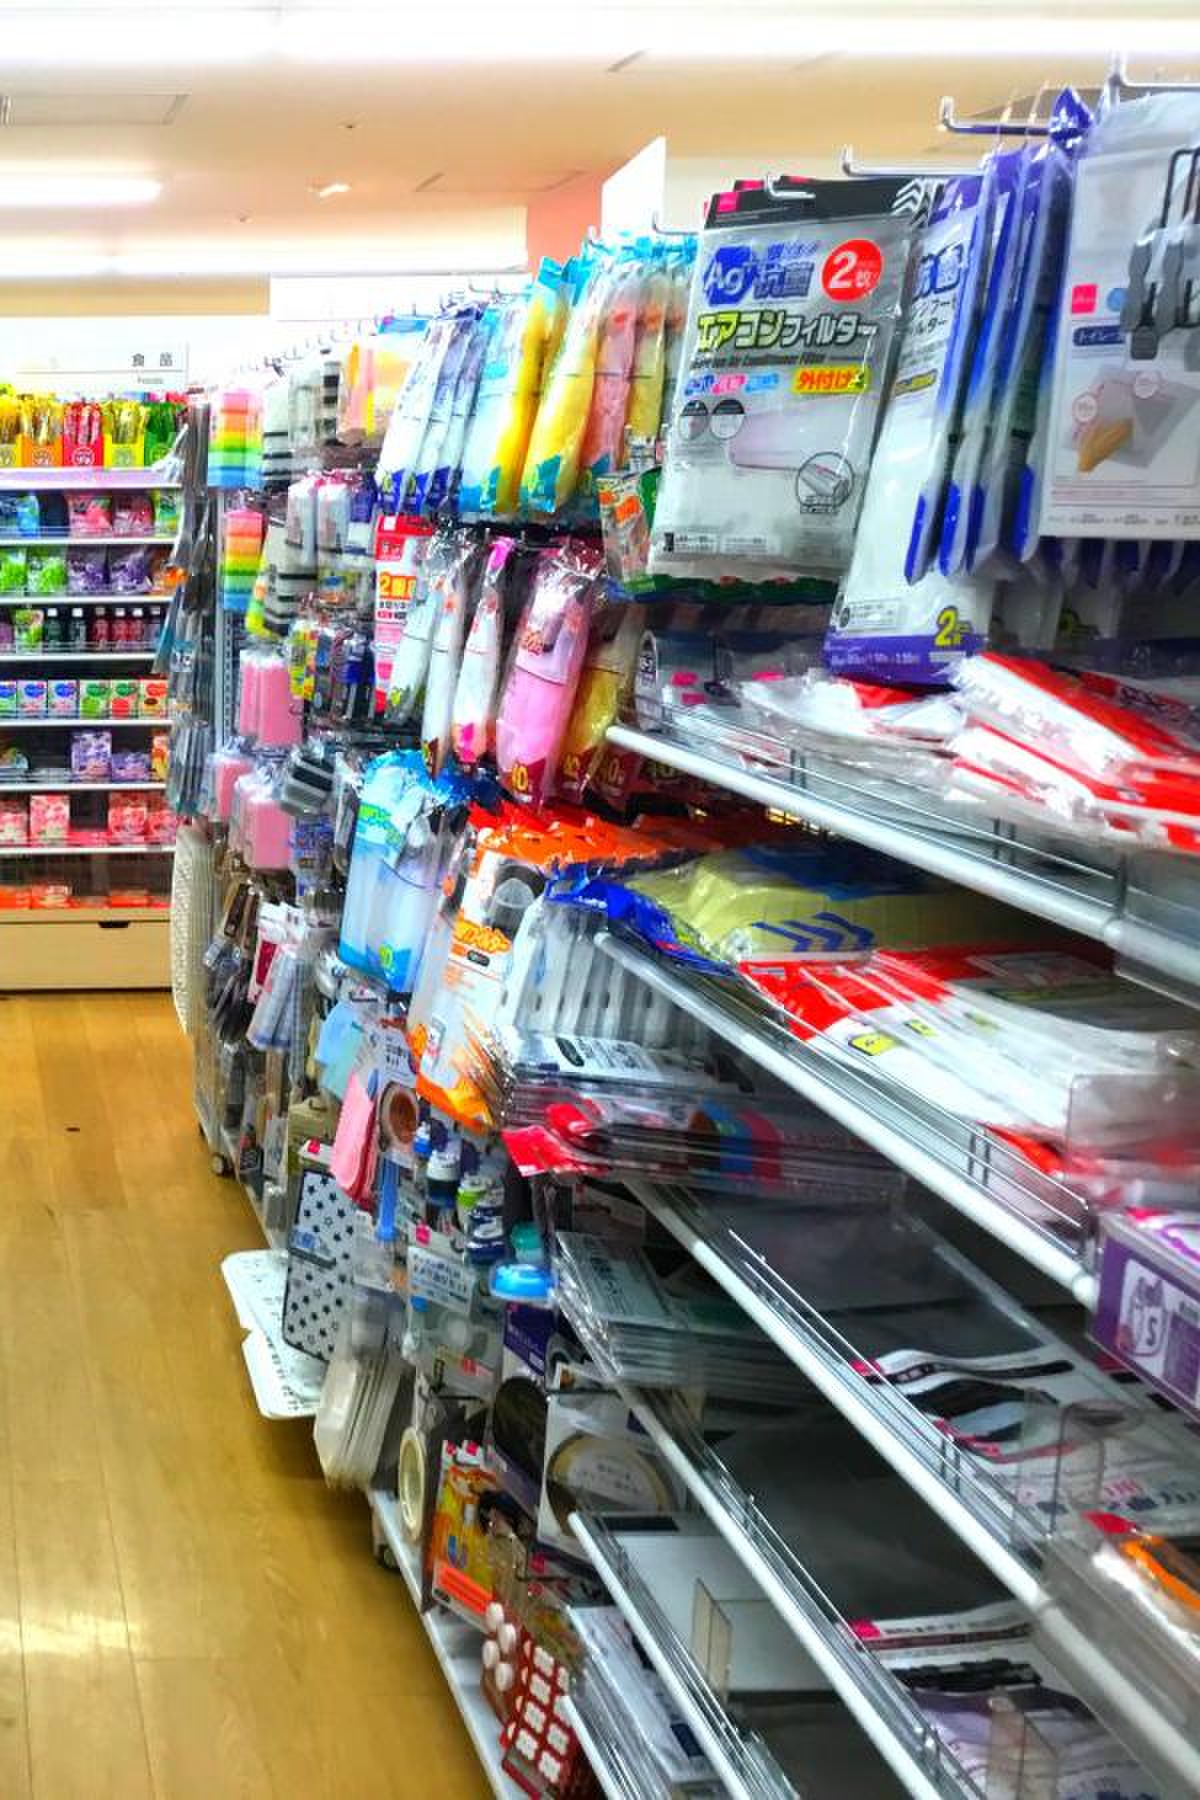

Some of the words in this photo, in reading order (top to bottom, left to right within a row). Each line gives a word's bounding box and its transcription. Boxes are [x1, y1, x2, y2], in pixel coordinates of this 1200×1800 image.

[697, 310, 879, 351] エアコンフィルター
